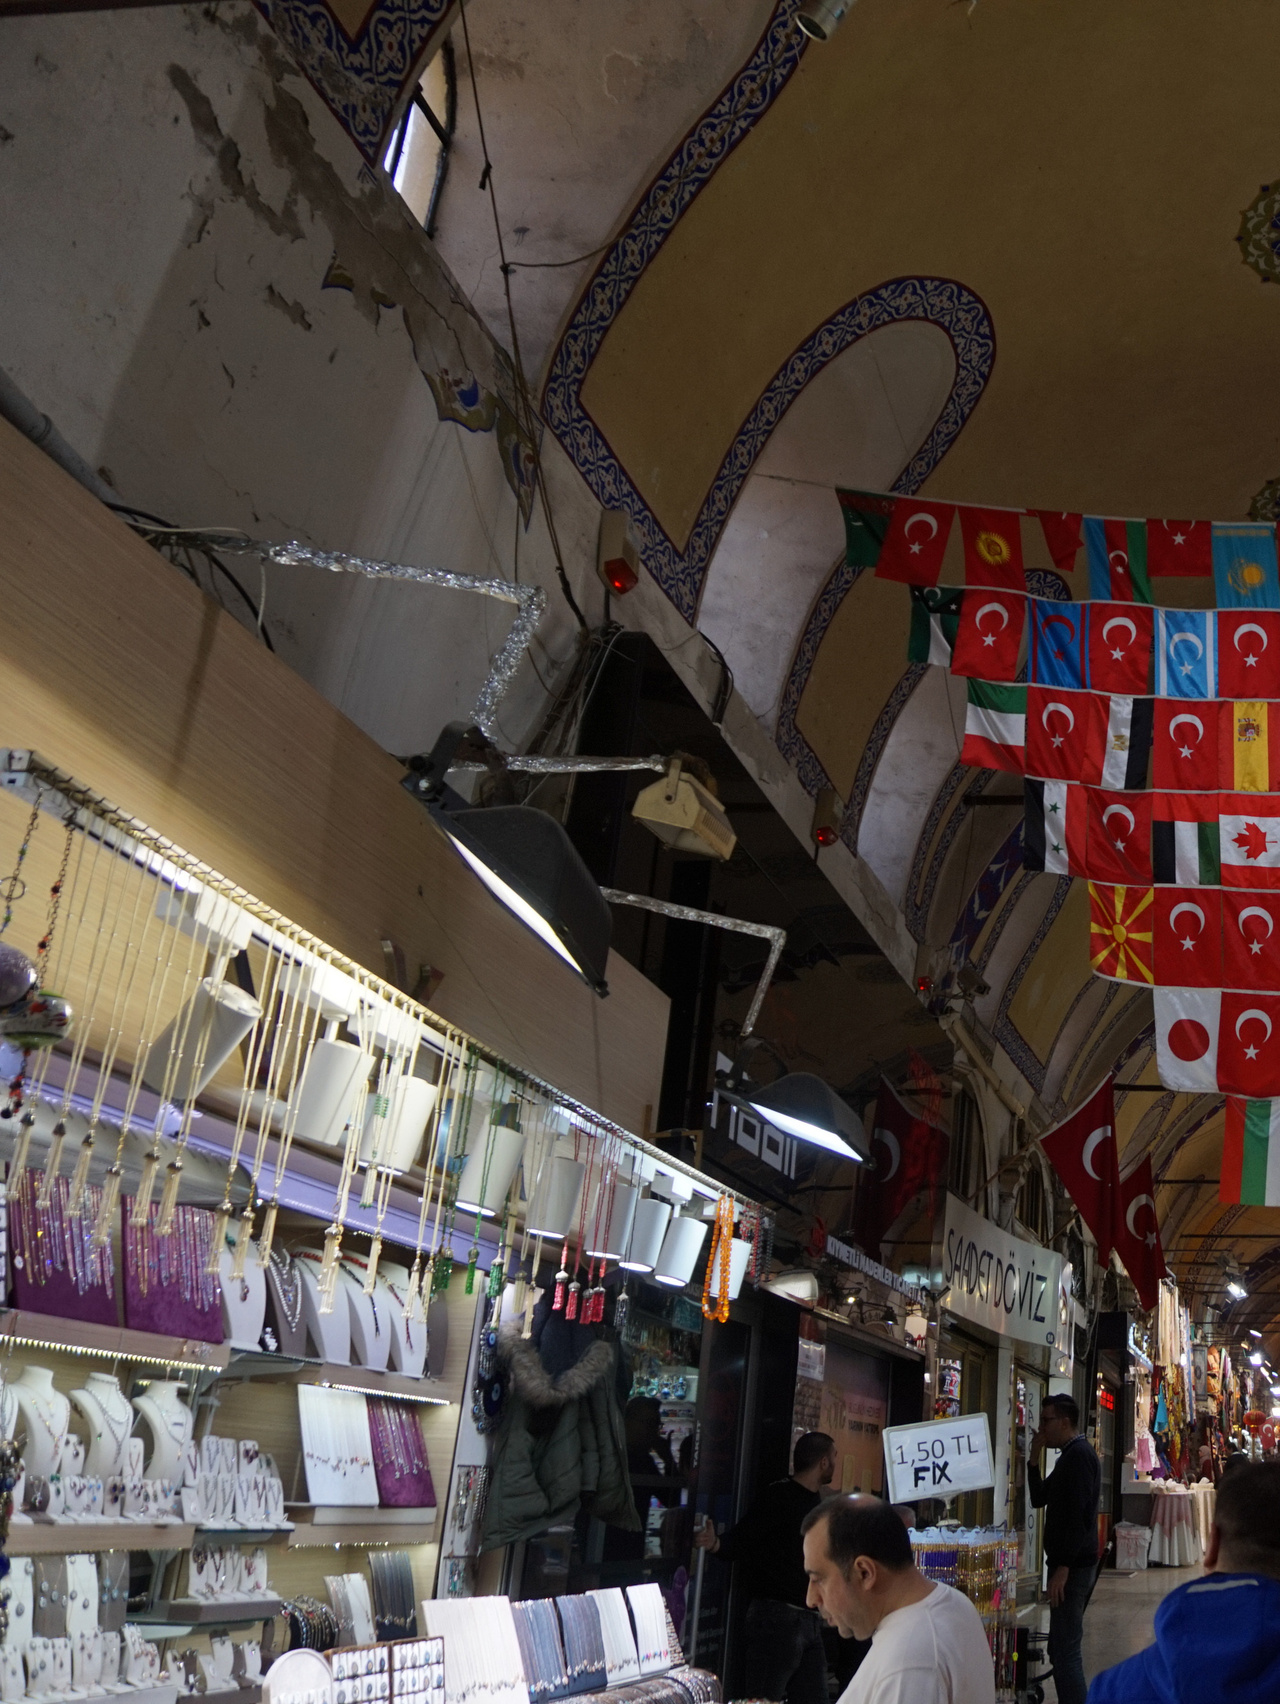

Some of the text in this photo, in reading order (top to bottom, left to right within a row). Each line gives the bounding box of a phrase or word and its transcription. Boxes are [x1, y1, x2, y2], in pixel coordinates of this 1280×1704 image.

[945, 1228, 1048, 1324] SAADET DÖVİZ
[895, 1434, 979, 1467] 1,50 TL
[913, 1461, 952, 1488] FİX
